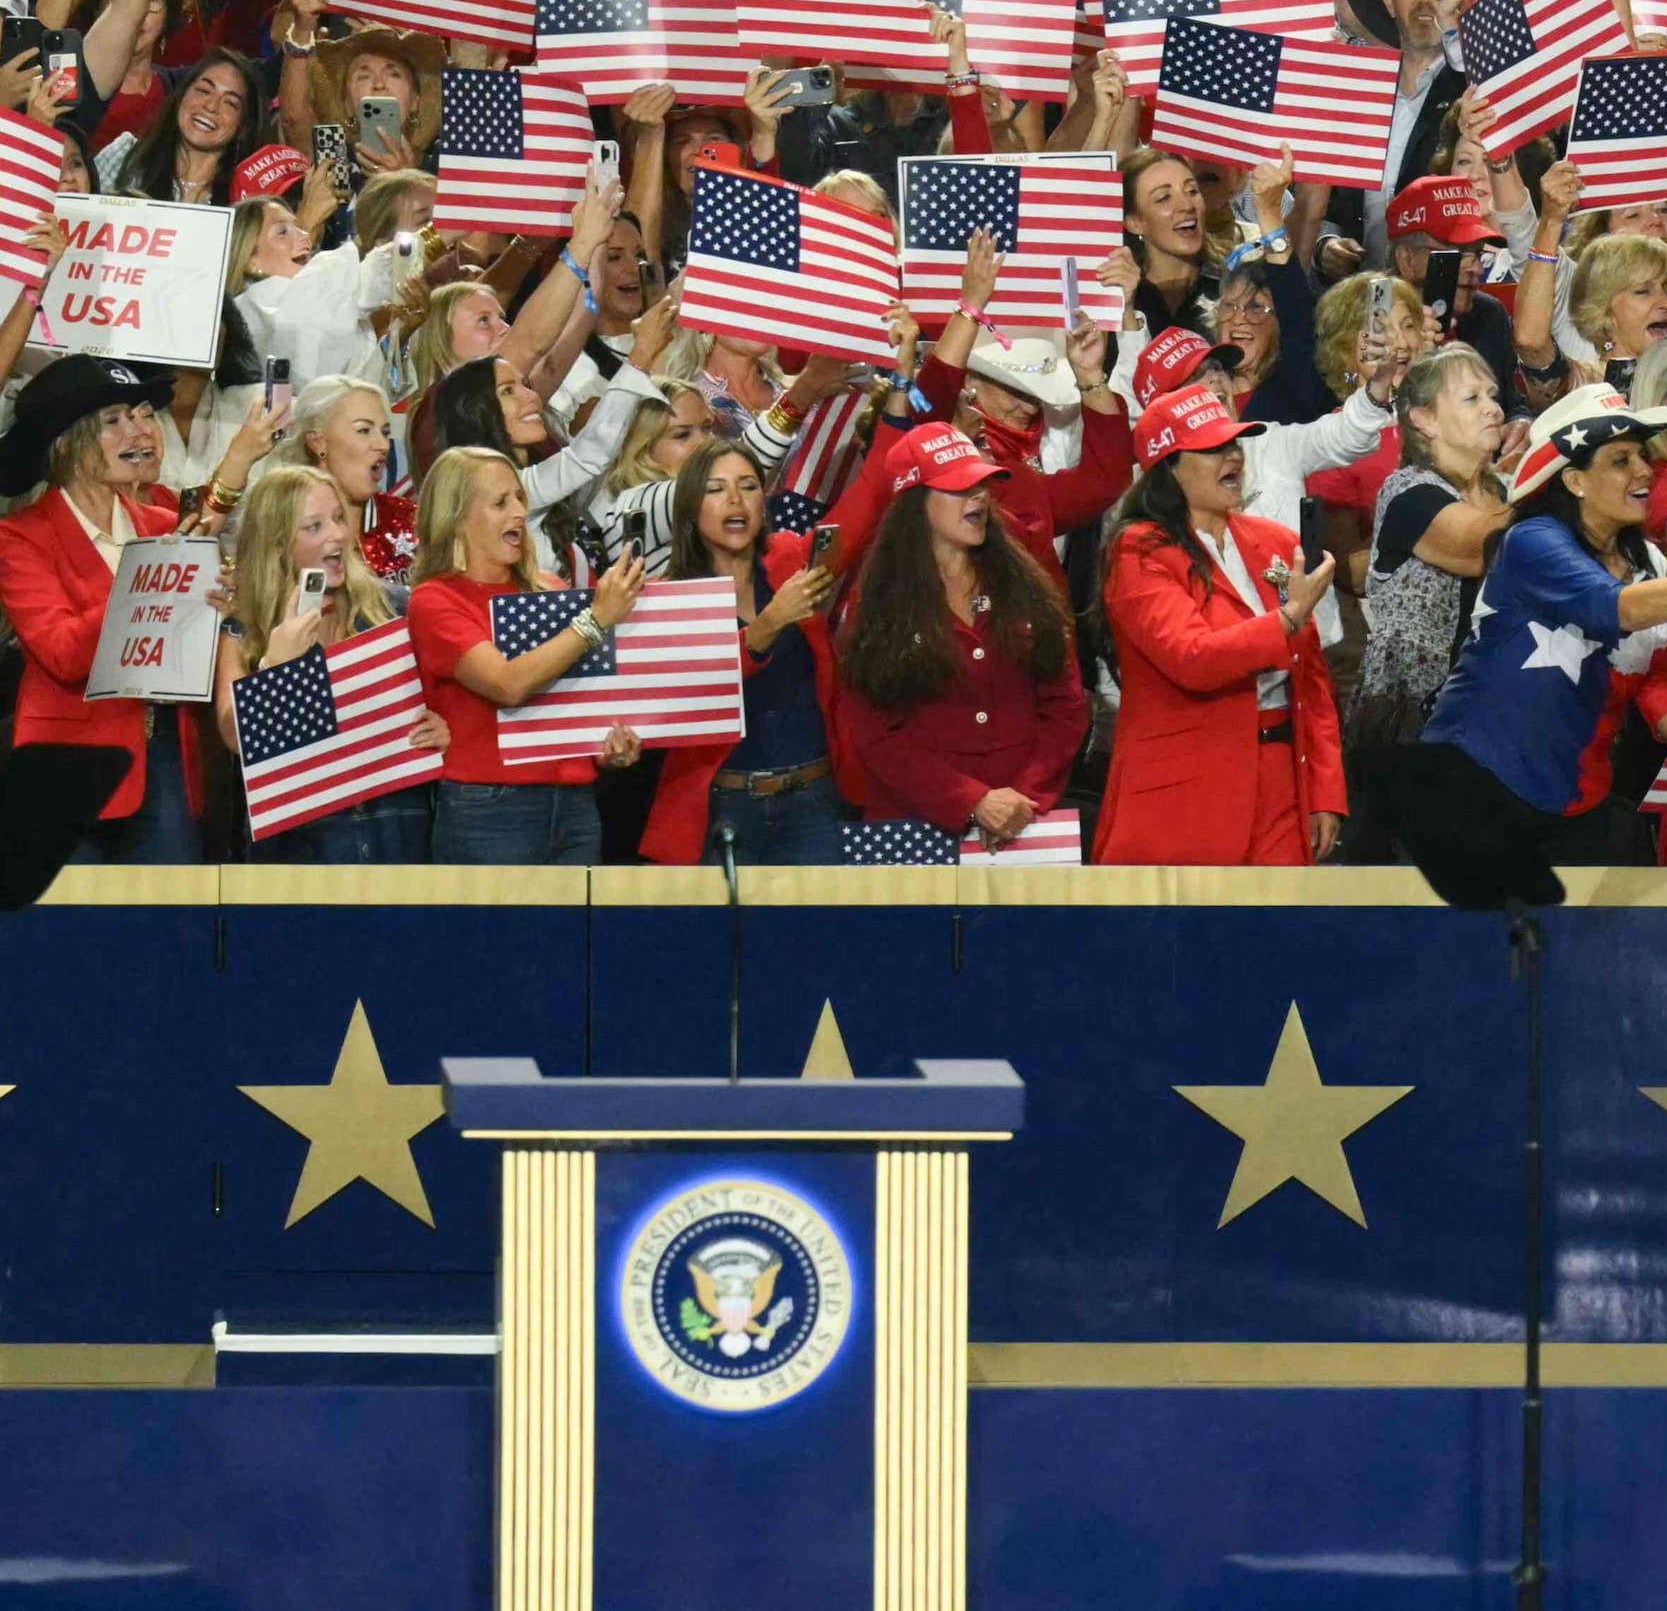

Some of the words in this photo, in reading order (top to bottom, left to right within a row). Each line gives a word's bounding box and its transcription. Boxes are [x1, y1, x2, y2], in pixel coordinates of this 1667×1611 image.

[244, 154, 273, 180] MAKE
[258, 166, 288, 189] GREAT
[1433, 185, 1465, 201] MAKE
[1397, 206, 1426, 228] 45-47
[1442, 203, 1475, 218] GREAT
[61, 217, 177, 259] MADE
[67, 261, 93, 282] IN
[100, 264, 146, 286] THE
[61, 292, 142, 330] USA
[1147, 338, 1172, 364] MAKE
[1163, 343, 1194, 369] GREAT
[1171, 395, 1202, 419] MAKE
[1187, 406, 1219, 430] GREAT
[922, 435, 950, 454] MAKE
[934, 446, 965, 465] GREAT
[1147, 427, 1175, 459] 45-47
[128, 563, 200, 594] MADE
[131, 606, 146, 625] IN
[147, 605, 173, 624] THE
[120, 635, 165, 669] USA
[742, 1191, 761, 1207] OF
[767, 1198, 796, 1222] THE
[631, 1187, 734, 1288] PRESIDENT
[800, 1218, 843, 1317] UNITED
[660, 1350, 713, 1398] SEAL
[757, 1329, 834, 1398] STATES
